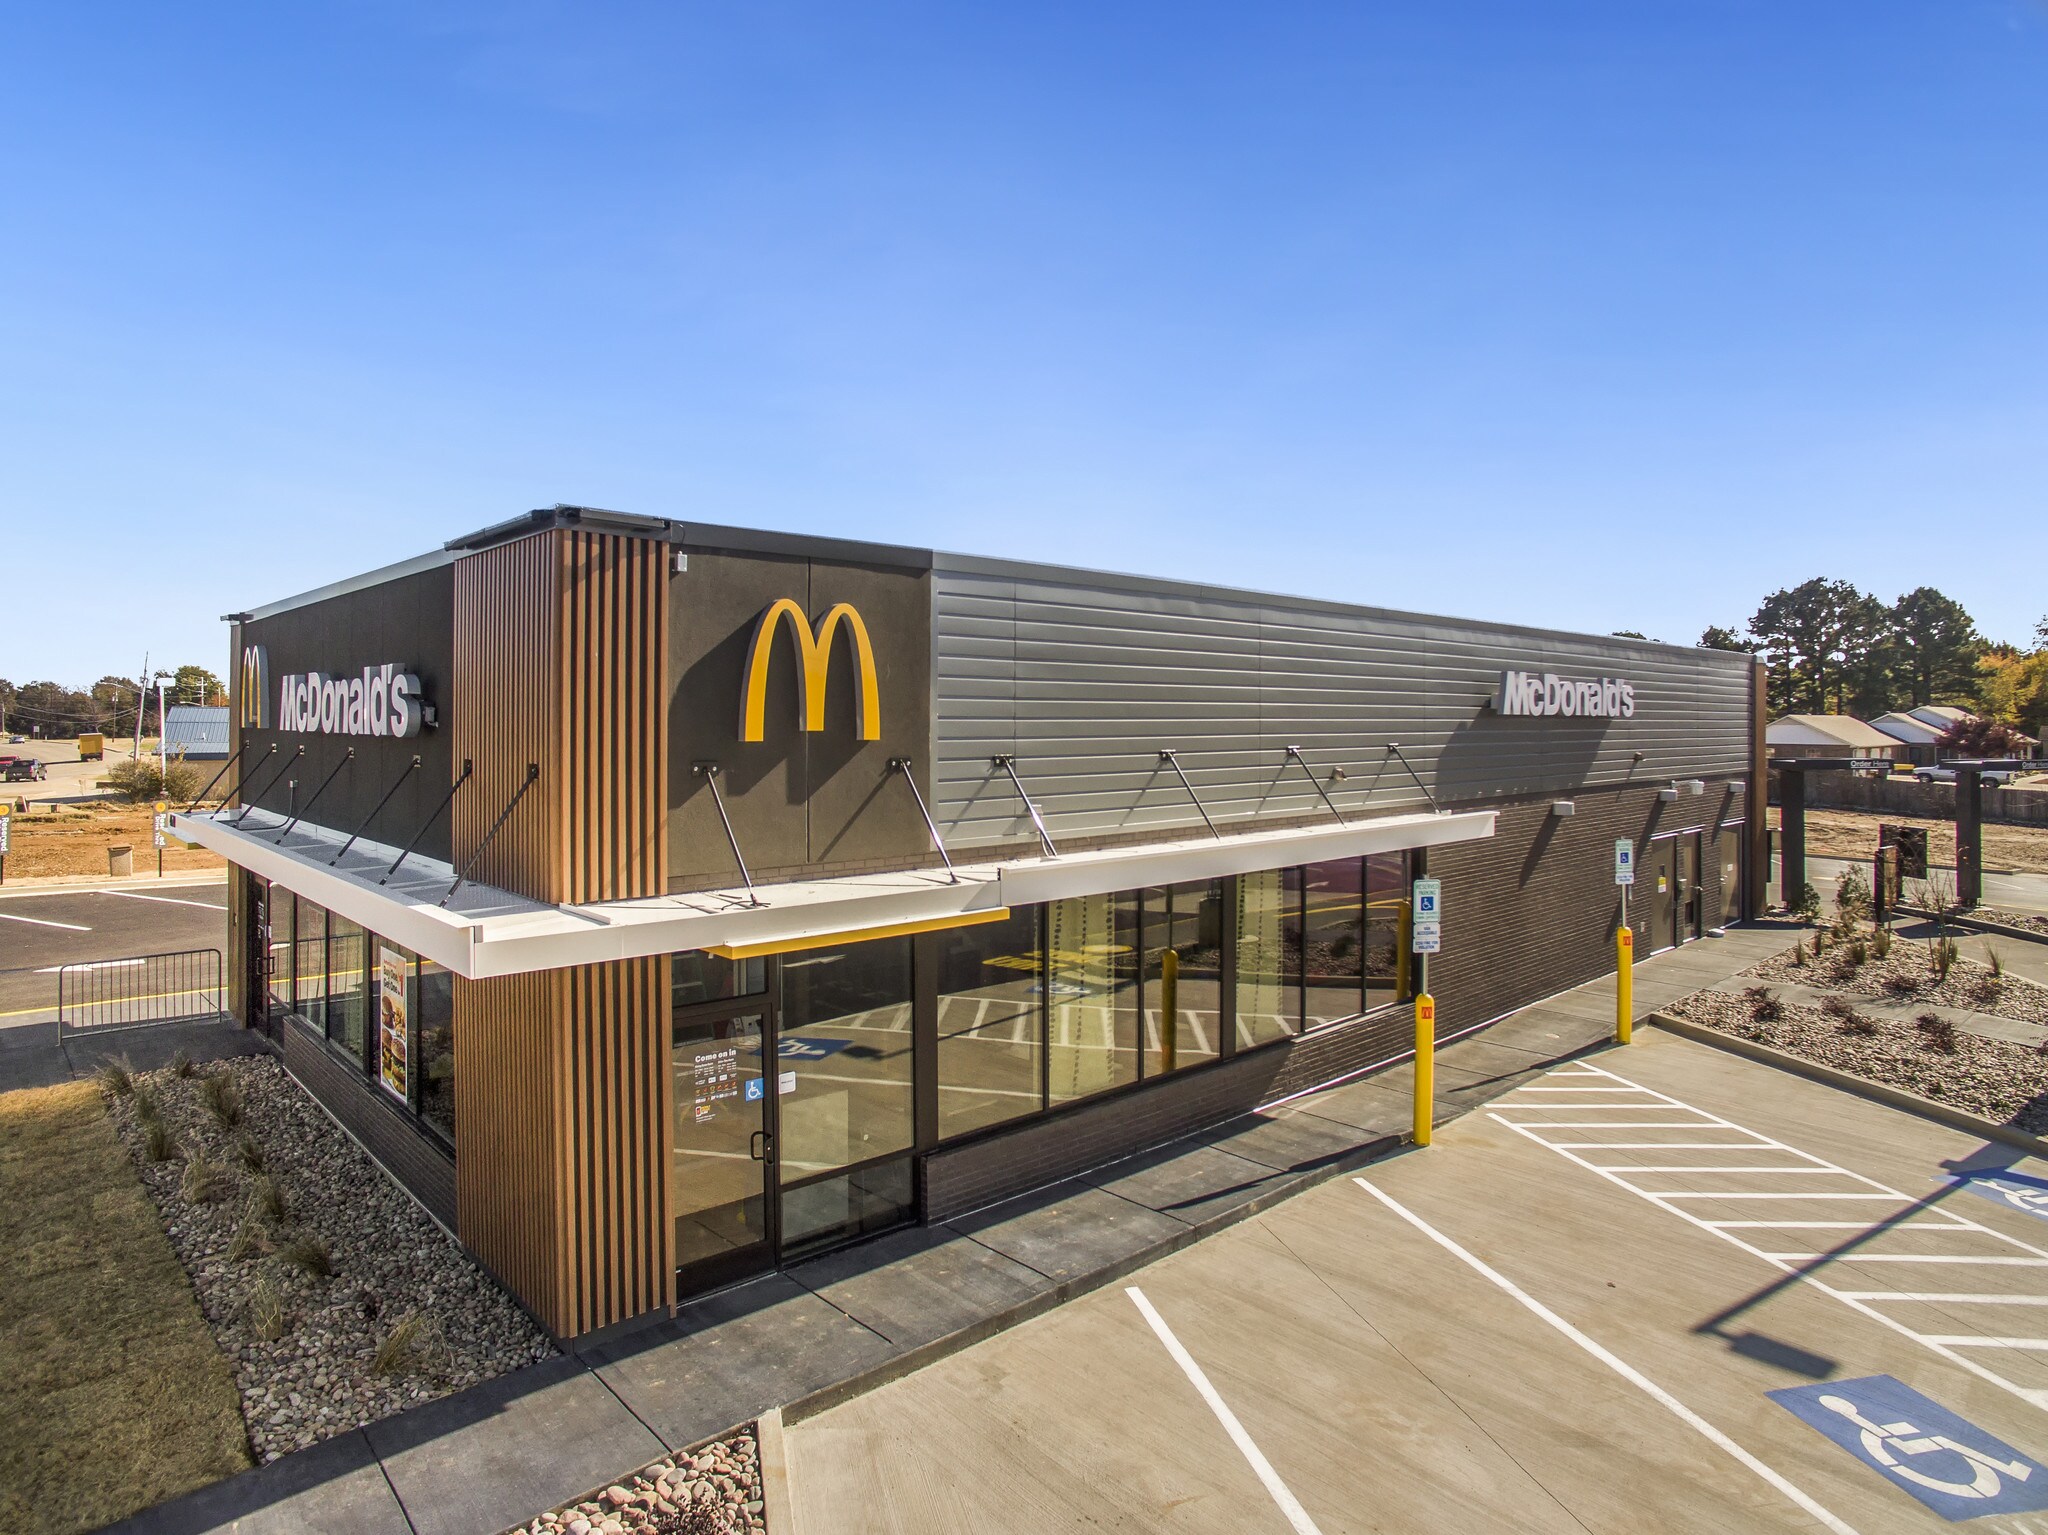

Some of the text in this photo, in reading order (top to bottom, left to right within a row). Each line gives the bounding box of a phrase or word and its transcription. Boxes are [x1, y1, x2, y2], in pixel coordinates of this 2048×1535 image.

[280, 663, 411, 738] McDonald's
[1502, 671, 1635, 718] McDonald's
[695, 1053, 717, 1063] Come
[729, 1048, 737, 1056] in
